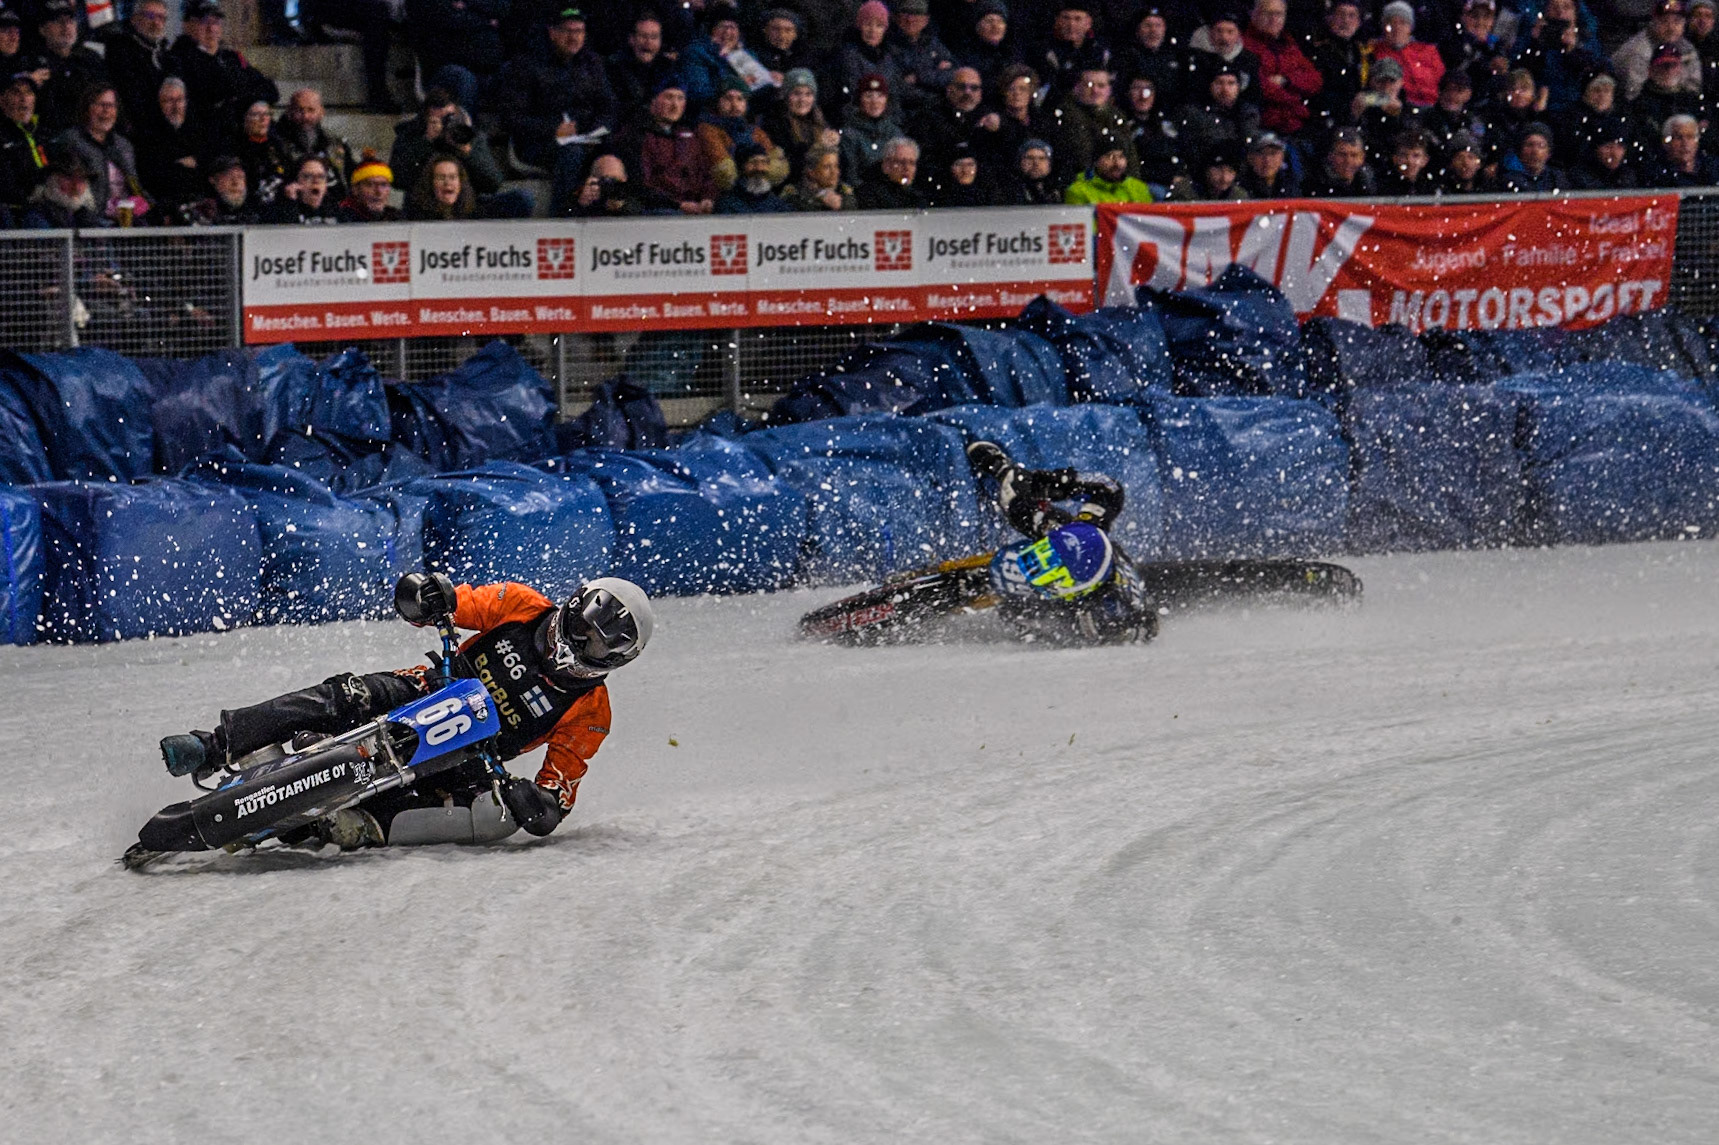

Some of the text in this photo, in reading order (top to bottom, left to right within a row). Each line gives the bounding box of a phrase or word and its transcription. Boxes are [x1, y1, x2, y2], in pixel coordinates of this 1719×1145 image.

[419, 244, 532, 275] Josef Fuchs
[591, 240, 706, 272] Josef Fuchs
[756, 236, 870, 267] Josef Fuchs
[929, 230, 1043, 262] Josef Fuchs
[1411, 245, 1487, 275] Jugend
[1502, 242, 1577, 268] Familie
[252, 249, 369, 281] Josef Fuchs
[252, 310, 412, 331] Menschen. Bauen. Werte.
[418, 305, 577, 324] Menschen. Bauen. Werte.
[494, 639, 527, 681] #66
[415, 697, 472, 746] 66
[237, 769, 332, 819] AUTOTARVIKE
[332, 762, 346, 780] OY
